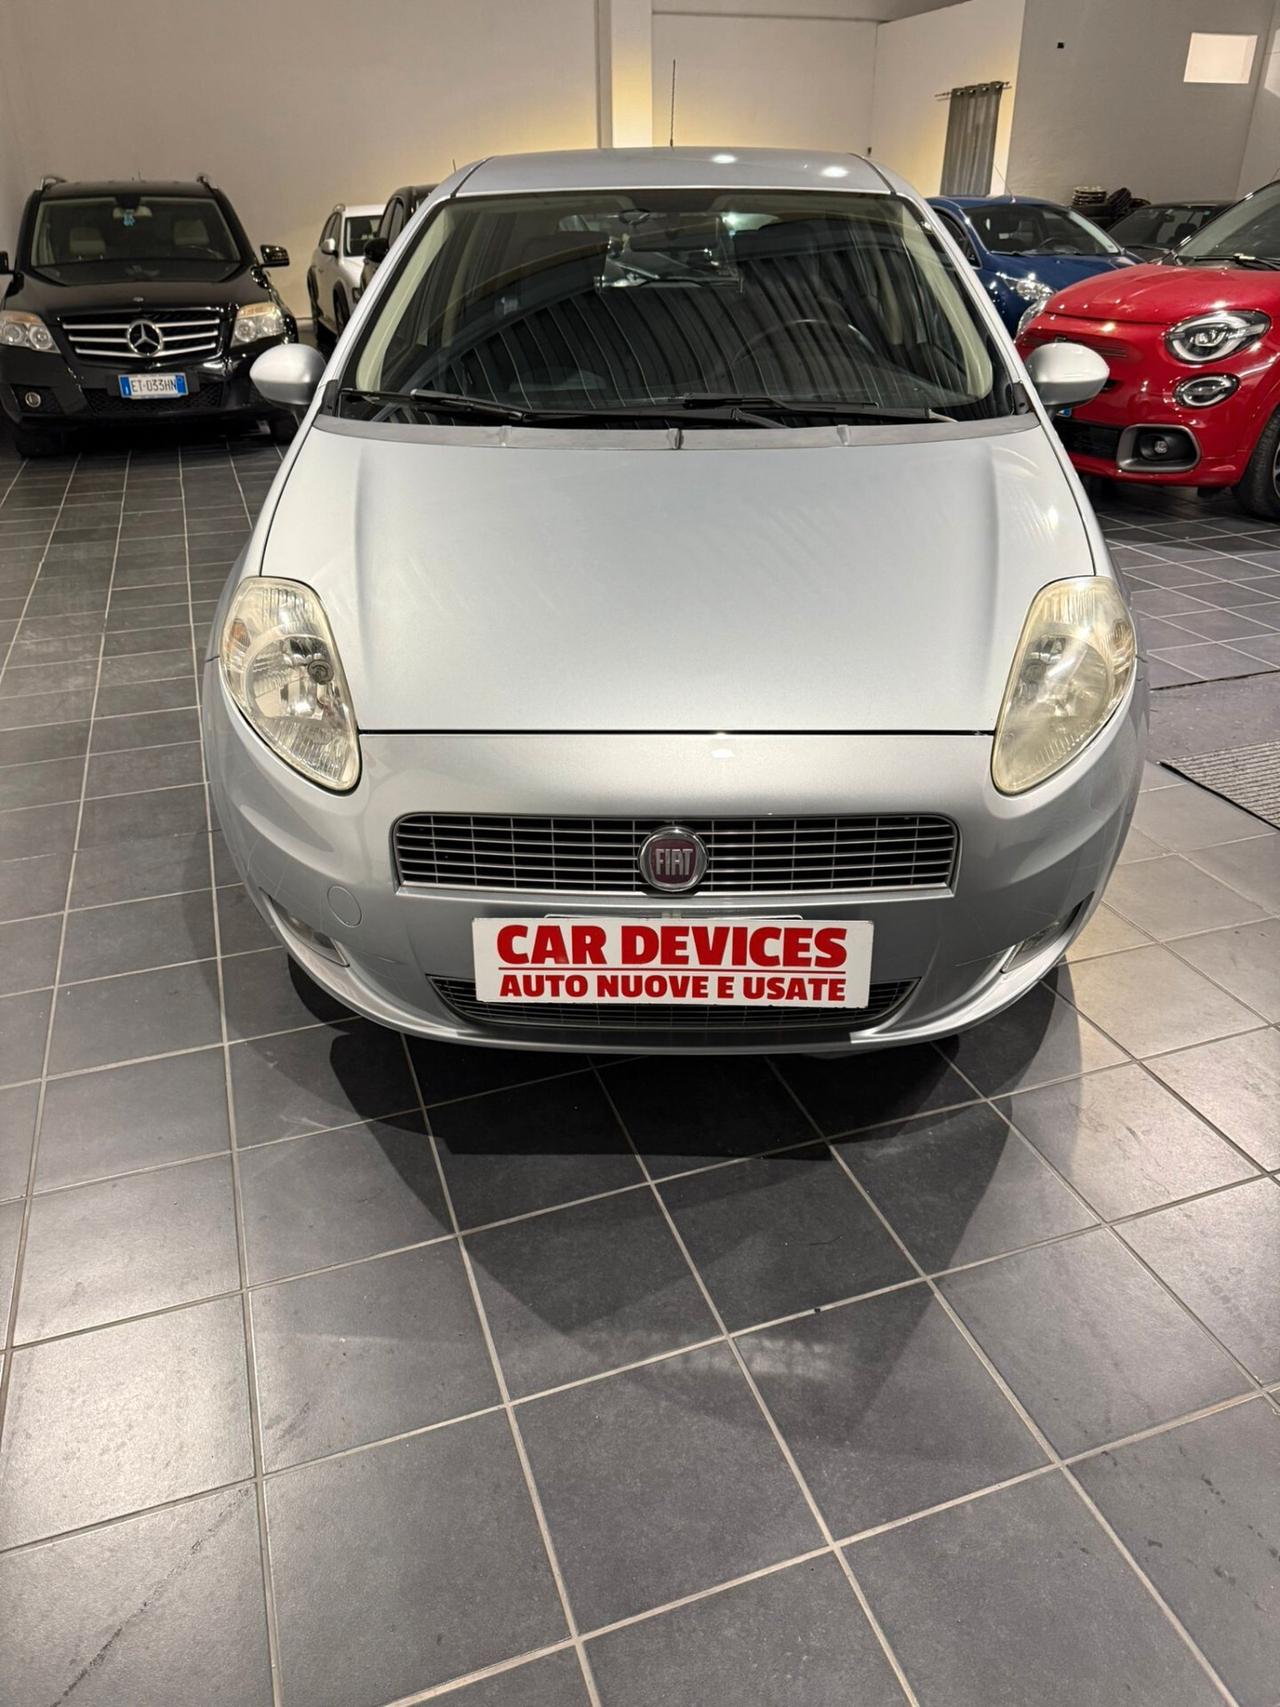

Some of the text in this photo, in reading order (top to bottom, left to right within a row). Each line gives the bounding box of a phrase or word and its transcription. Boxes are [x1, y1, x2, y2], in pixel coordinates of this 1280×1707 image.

[655, 848, 694, 876] FIAT
[496, 925, 848, 969] CAR DEVICES
[499, 974, 845, 1002] AUTO NUOVE E USATE
